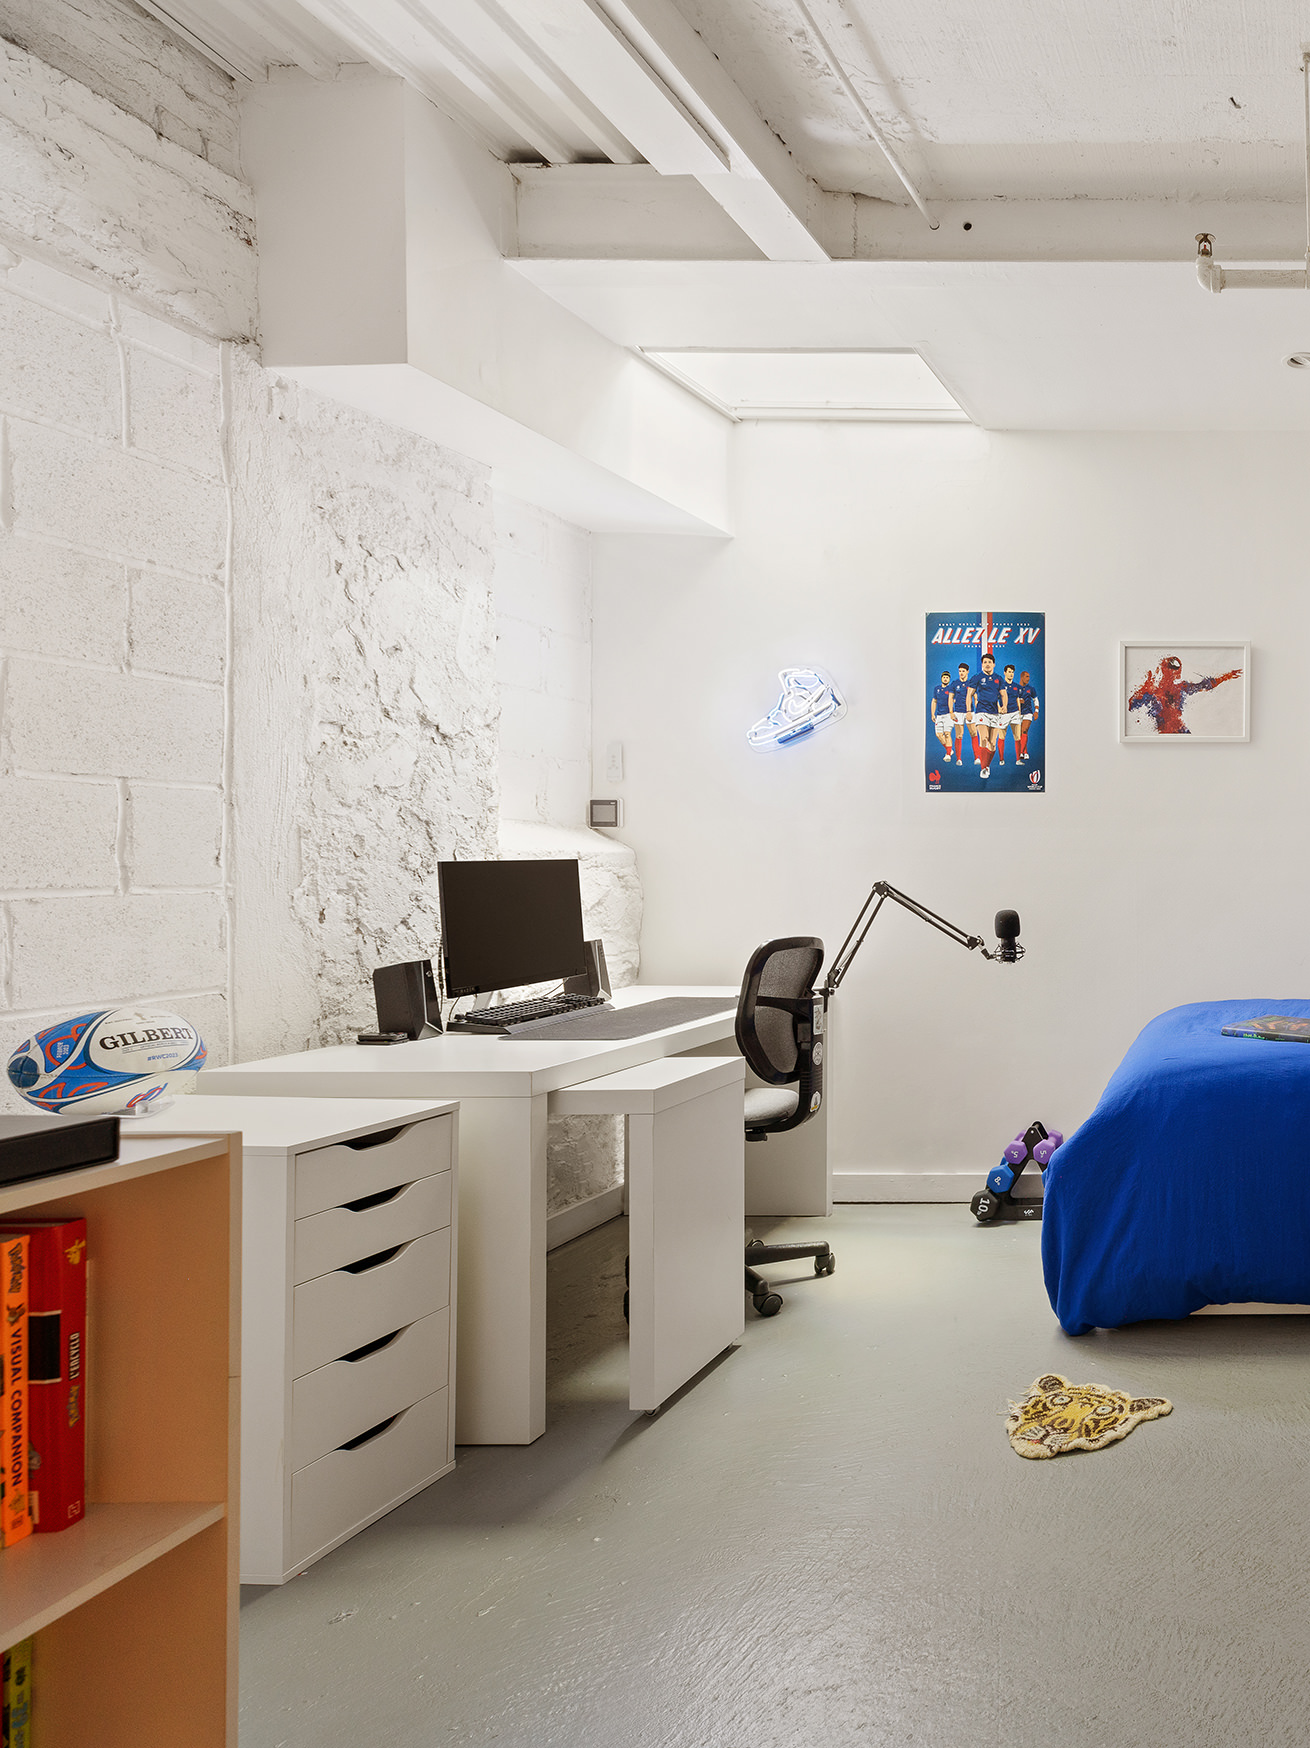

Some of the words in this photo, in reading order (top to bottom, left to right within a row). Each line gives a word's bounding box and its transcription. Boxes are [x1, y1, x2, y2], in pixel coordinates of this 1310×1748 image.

[930, 627, 986, 644] ALLEZ
[987, 627, 1012, 644] LE
[1013, 627, 1041, 644] XV
[99, 1027, 194, 1051] GILBERT
[978, 1197, 990, 1213] 10
[11, 1327, 22, 1386] VISUAL
[11, 1390, 23, 1487] COMPANION
